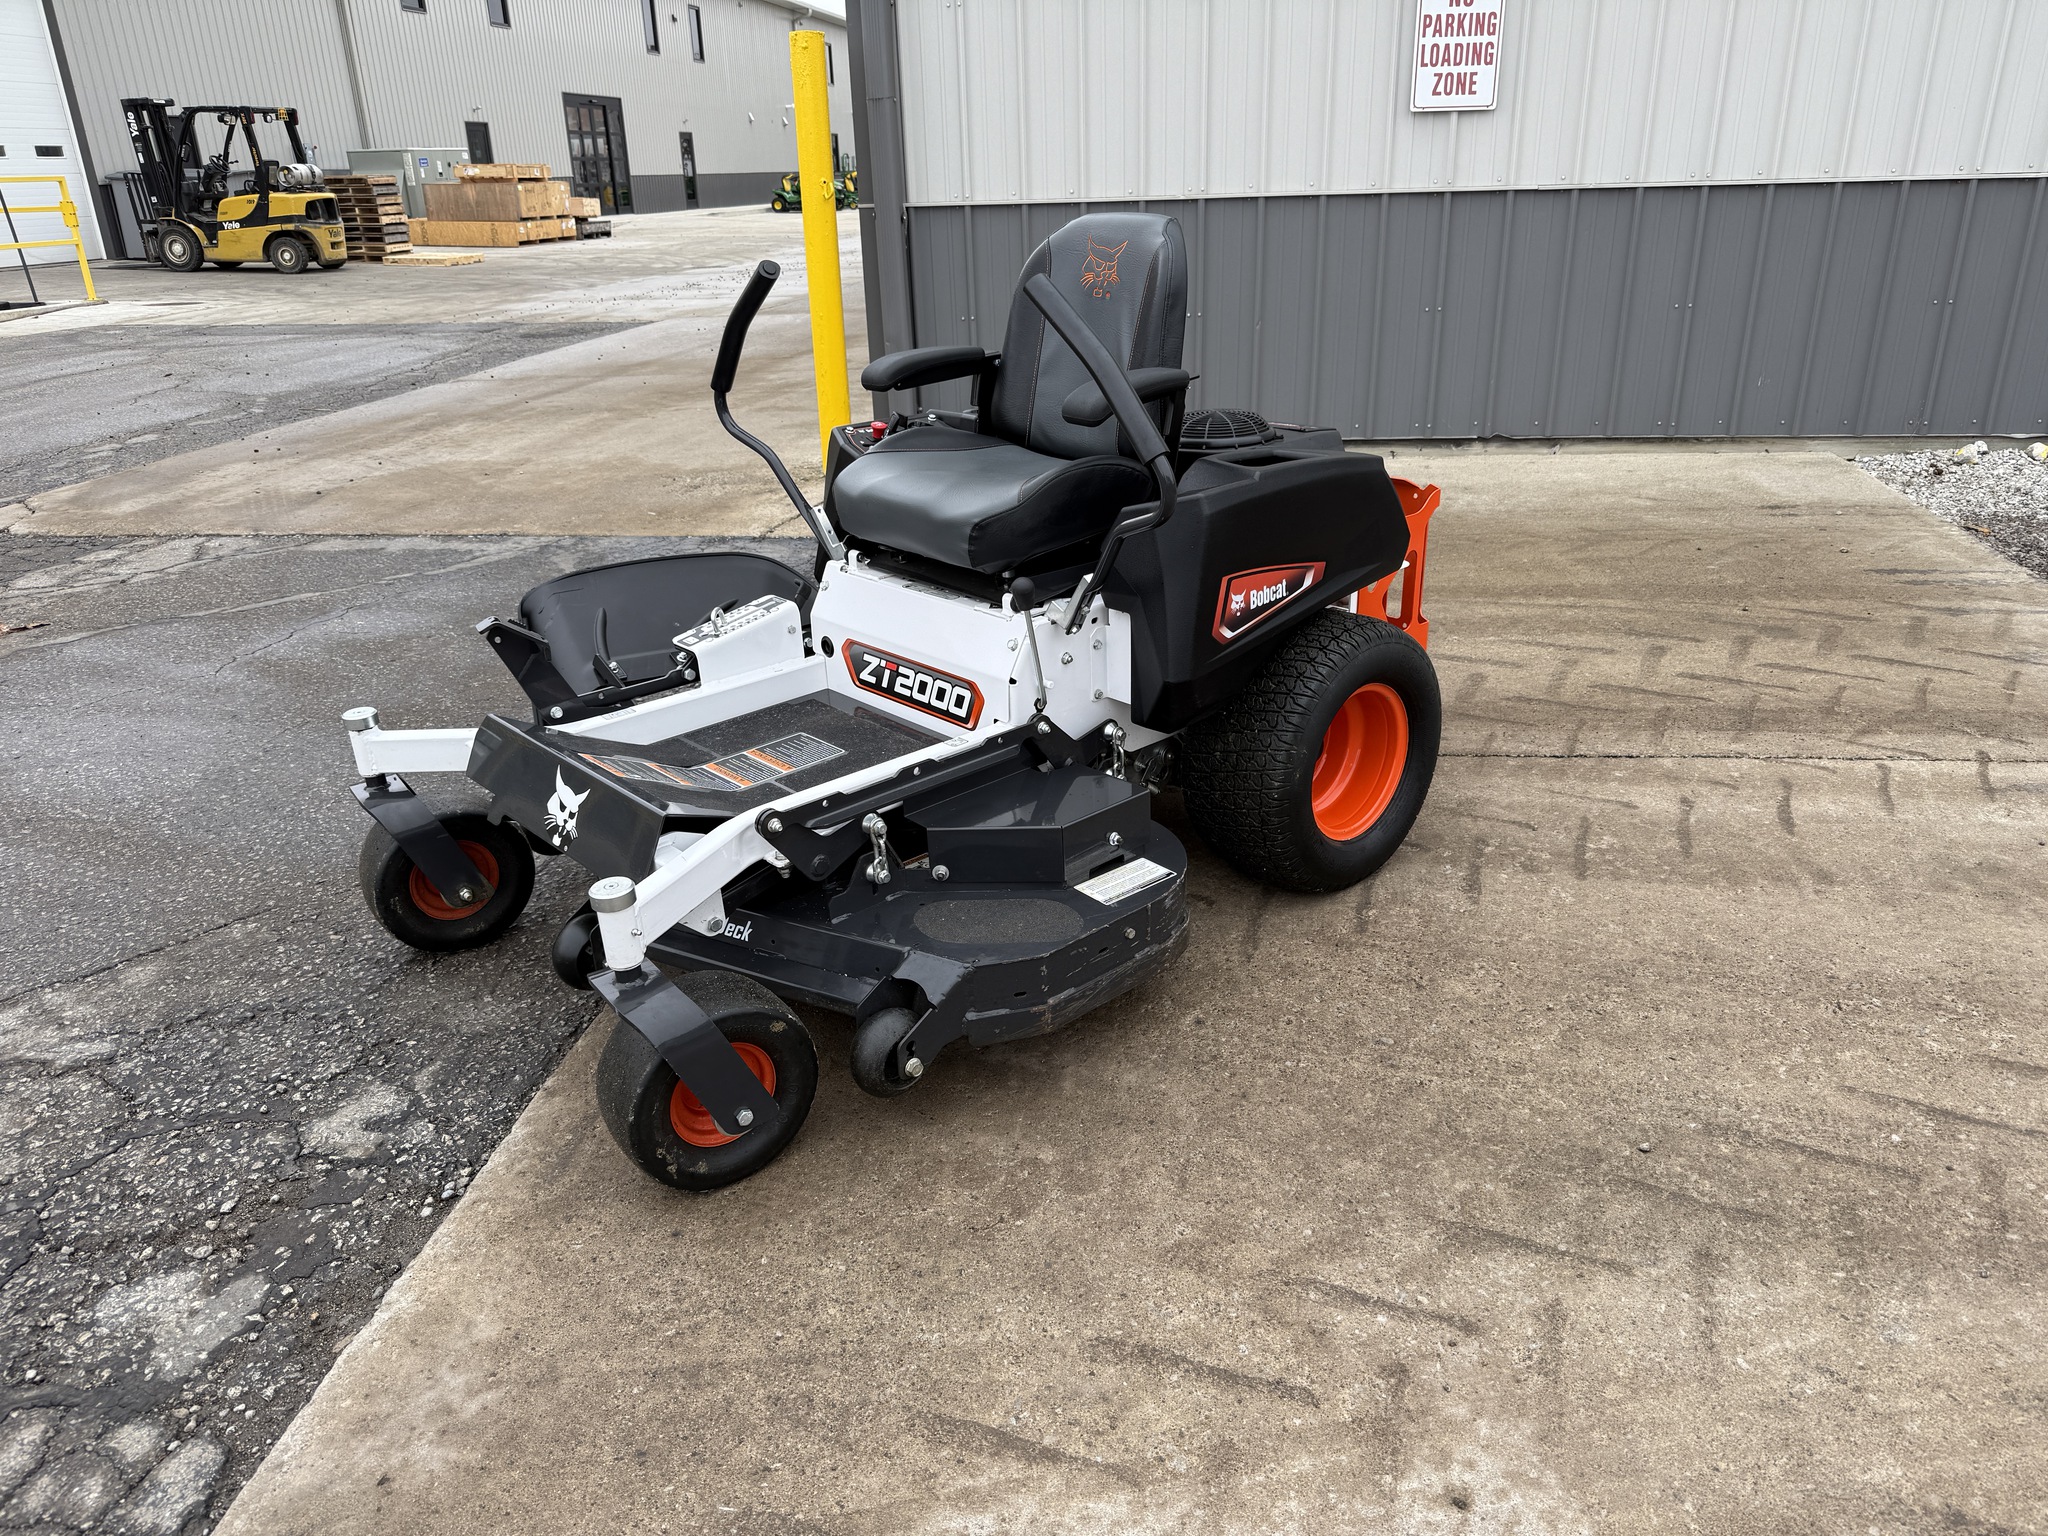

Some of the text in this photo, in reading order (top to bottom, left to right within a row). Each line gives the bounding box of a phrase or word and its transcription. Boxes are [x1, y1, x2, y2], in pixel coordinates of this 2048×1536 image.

[1422, 12, 1497, 38] PARKING
[1420, 41, 1495, 68] LOADING
[1431, 72, 1478, 96] ZONE
[127, 112, 140, 137] Yale
[222, 221, 241, 230] Yale
[1250, 578, 1287, 610] Bobcat
[859, 653, 972, 718] ZT2000
